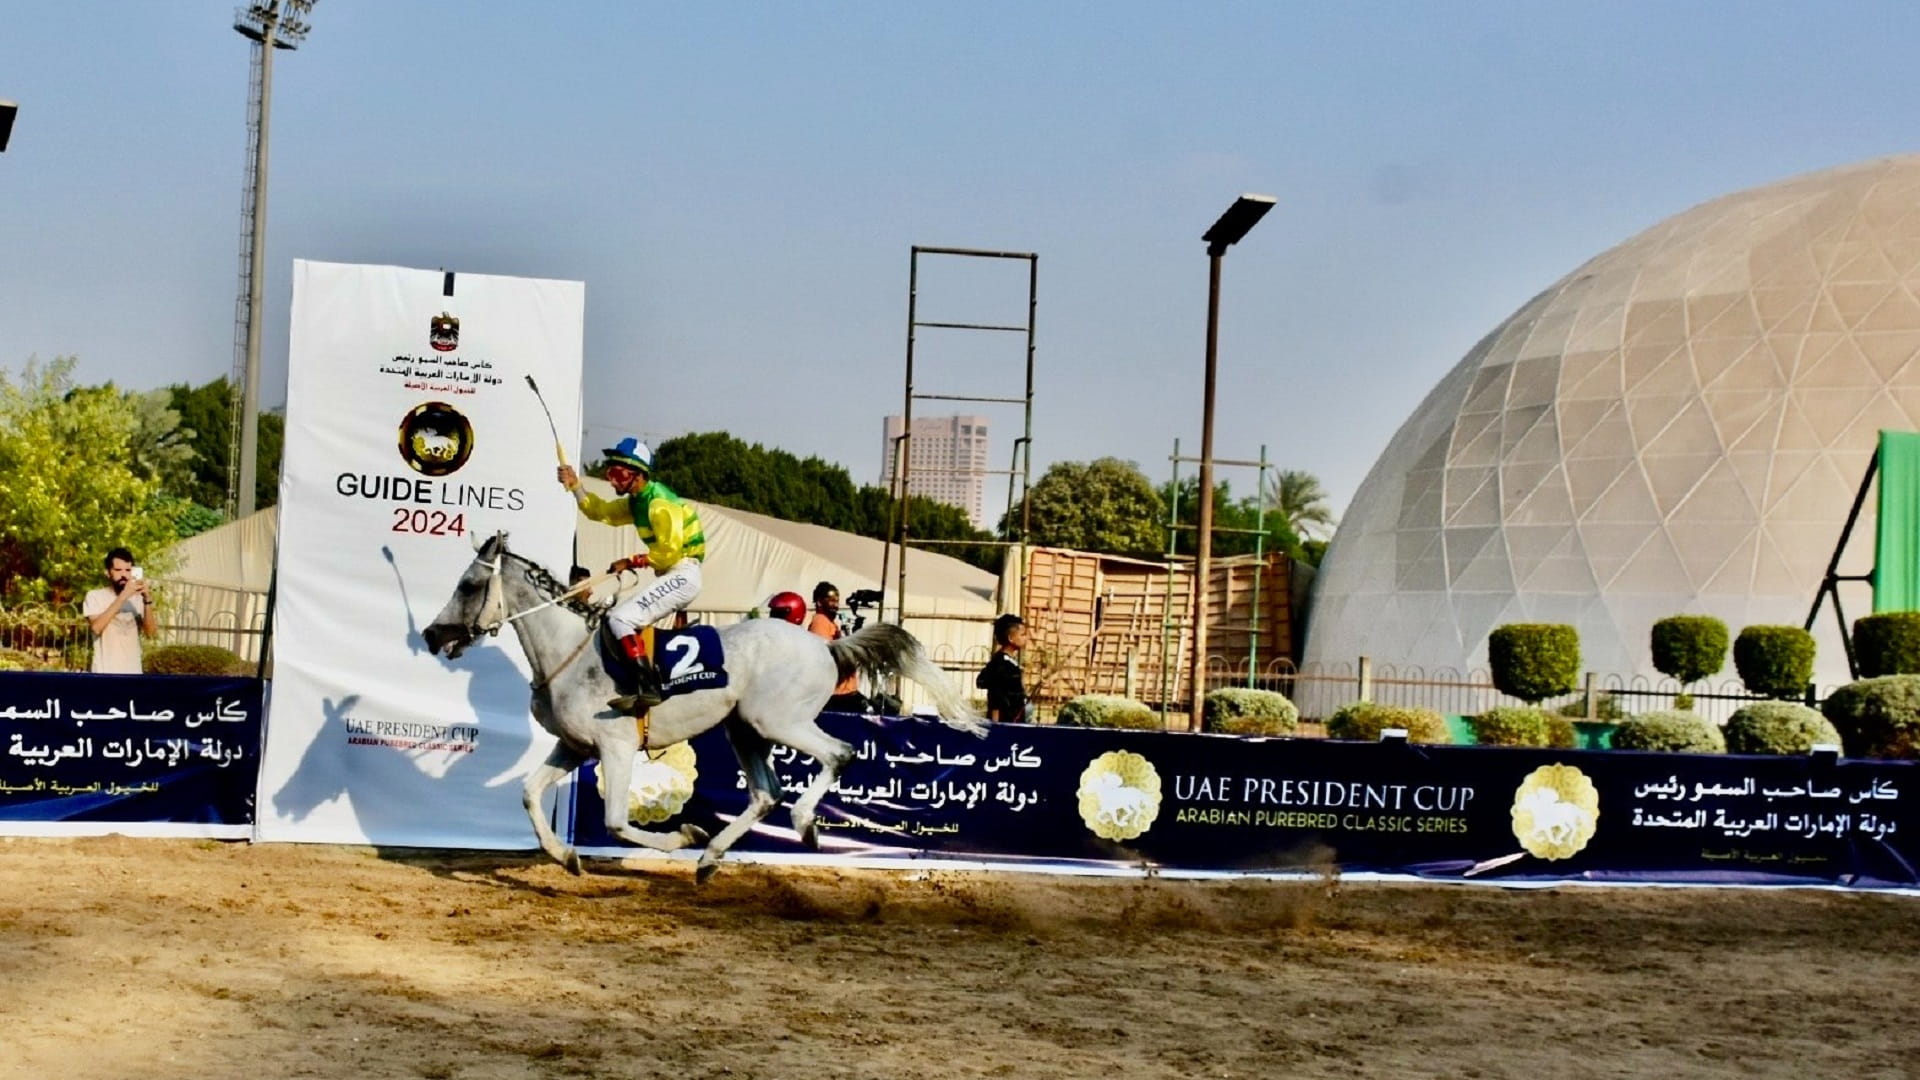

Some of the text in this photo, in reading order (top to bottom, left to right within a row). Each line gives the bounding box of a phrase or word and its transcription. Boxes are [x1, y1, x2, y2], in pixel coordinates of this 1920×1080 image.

[336, 473, 524, 511] GUIDE LINES
[392, 508, 465, 537] 2024
[636, 574, 688, 611] MARIOS
[665, 634, 704, 680] 2
[0, 697, 248, 728] كأس صاحب السم
[346, 718, 479, 742] UAE PRESIDENT CUP
[8, 733, 243, 768] دولة الإمارات العربية
[884, 744, 977, 769] صاحب
[984, 743, 1042, 772] كأس
[0, 778, 159, 795] للخيول العربية الأصيل
[910, 780, 987, 809] الإمارات
[995, 781, 1038, 812] دولة
[1175, 775, 1475, 811] UAE PRESIDENT CUP
[1634, 774, 1899, 804] كأس صاحب السمو رئيس
[911, 820, 959, 836] للخيول
[1175, 808, 1469, 833] ARABIAN PUREBRED CLASSIC SERIES
[1632, 807, 1897, 840] دولة الإمارات العربية المتحدة
